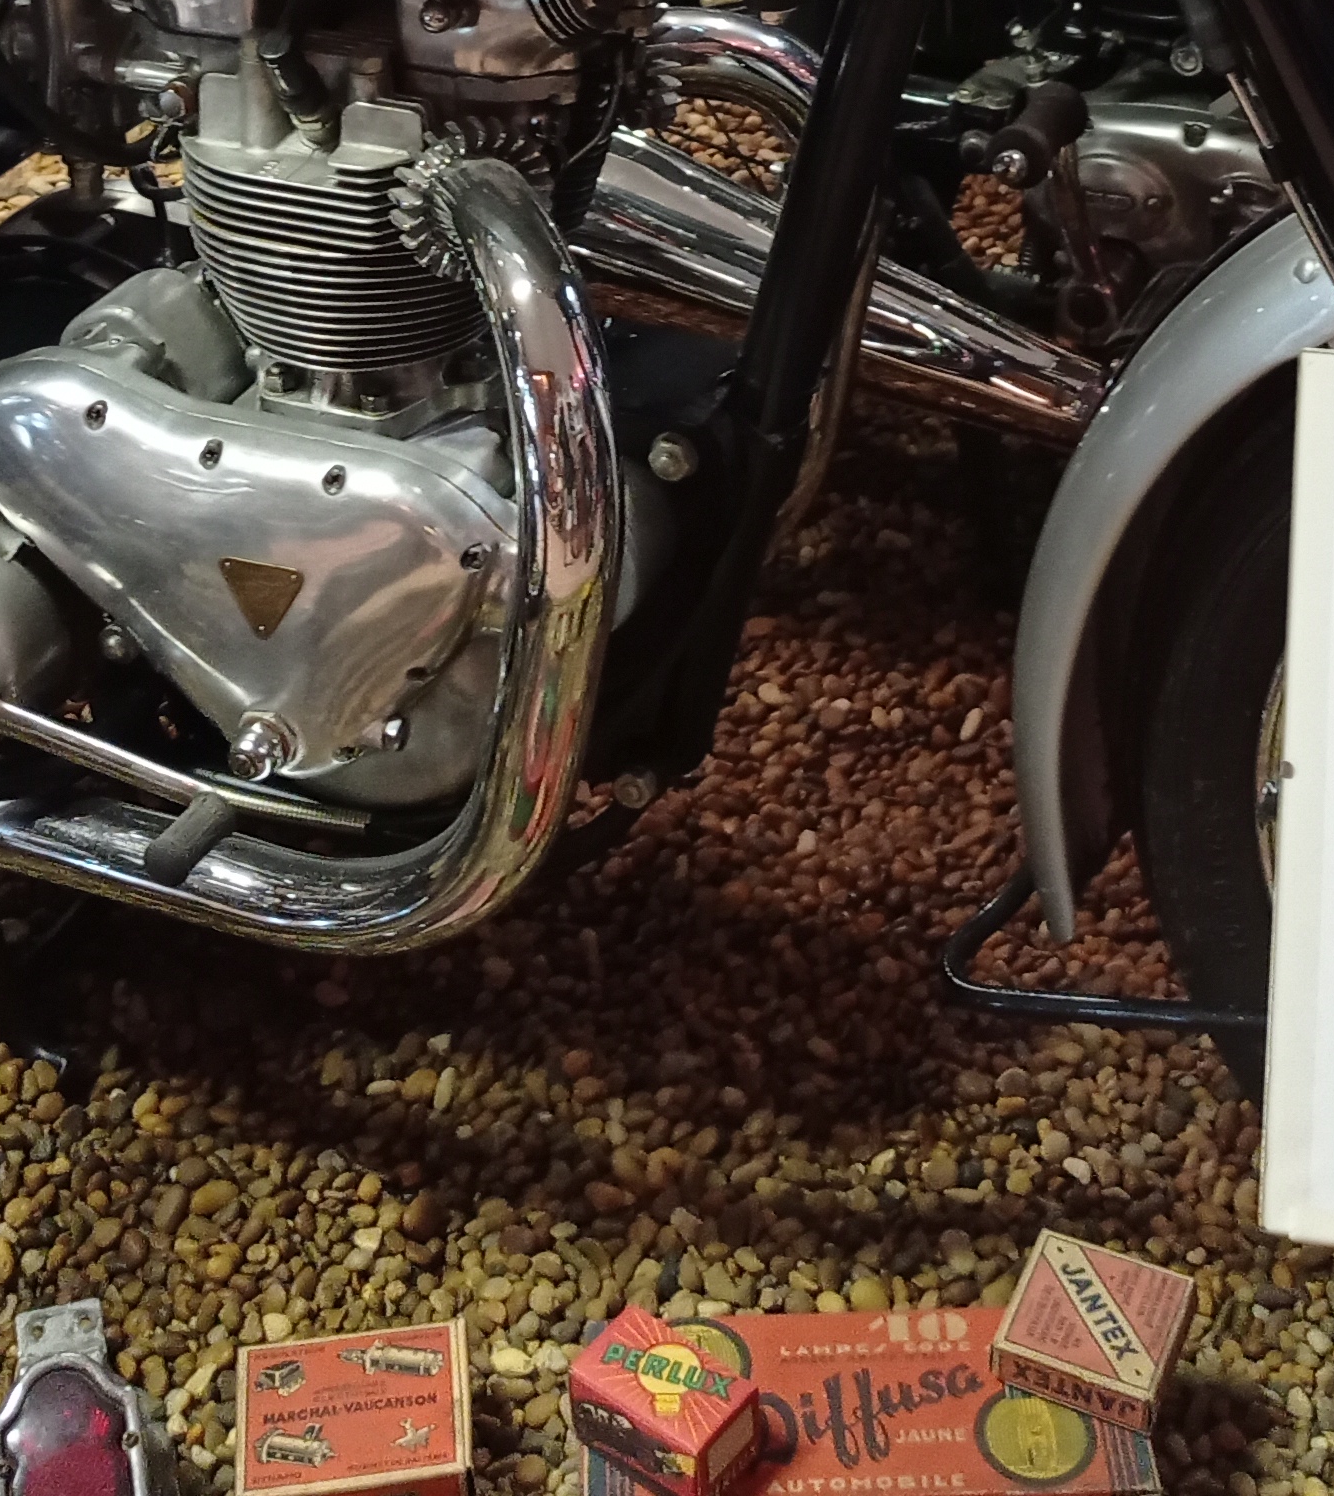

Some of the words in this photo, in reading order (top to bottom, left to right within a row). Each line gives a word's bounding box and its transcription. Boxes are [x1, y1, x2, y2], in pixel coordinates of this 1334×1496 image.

[869, 1312, 968, 1343] 10
[1060, 1263, 1139, 1361] JANTEX
[601, 1343, 735, 1401] PERLUX
[1013, 1359, 1138, 1413] JANTEX
[895, 1427, 967, 1444] JAUNE
[767, 1473, 966, 1494] AUTOMOBILE
